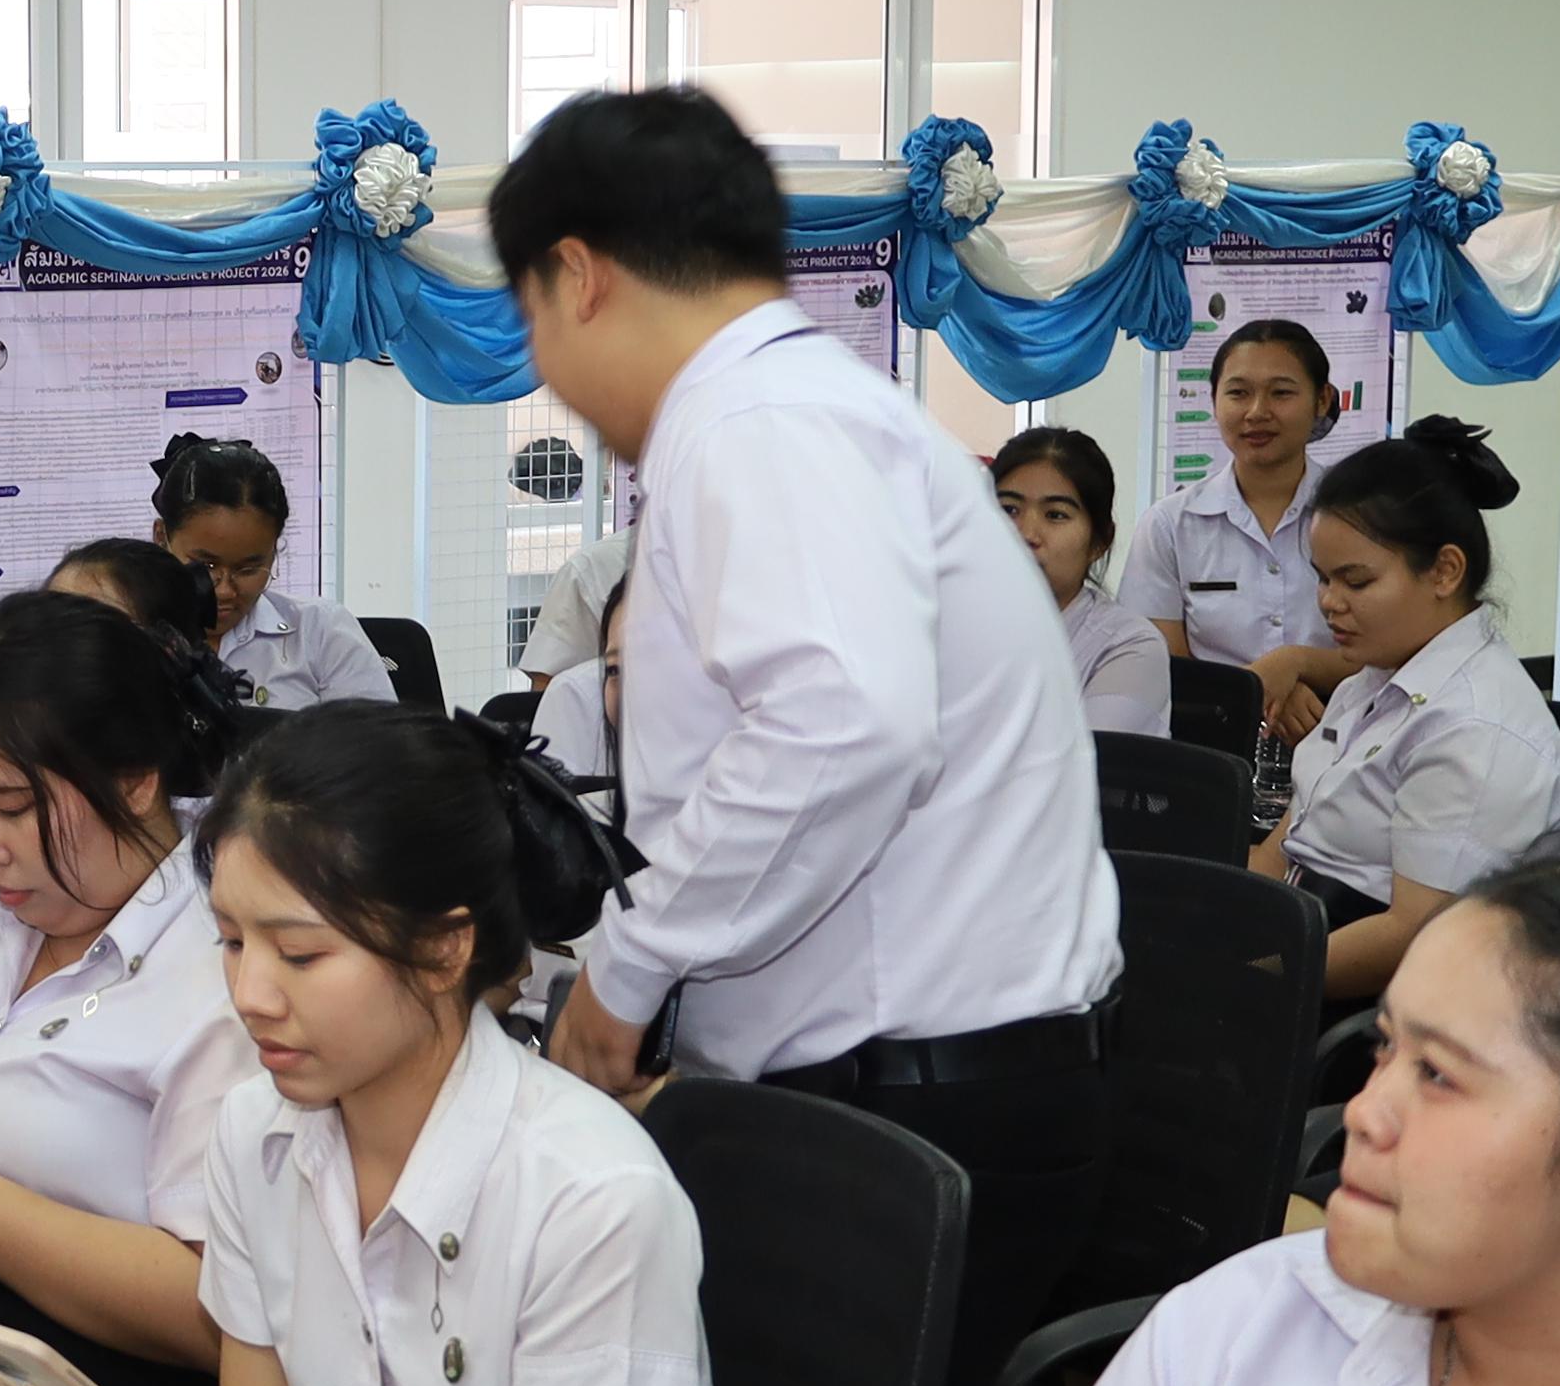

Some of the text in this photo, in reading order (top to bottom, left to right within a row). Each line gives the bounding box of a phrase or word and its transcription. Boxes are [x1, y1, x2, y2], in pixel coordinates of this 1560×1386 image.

[876, 238, 891, 266] 9
[1382, 232, 1393, 258] 9
[294, 246, 311, 278] 9
[786, 256, 871, 268] ENCE PROJECT 2026
[27, 272, 88, 285] ACADEMIC
[90, 271, 142, 283] SEMINAR
[211, 266, 258, 280] PROJECT
[261, 266, 289, 277] 2026
